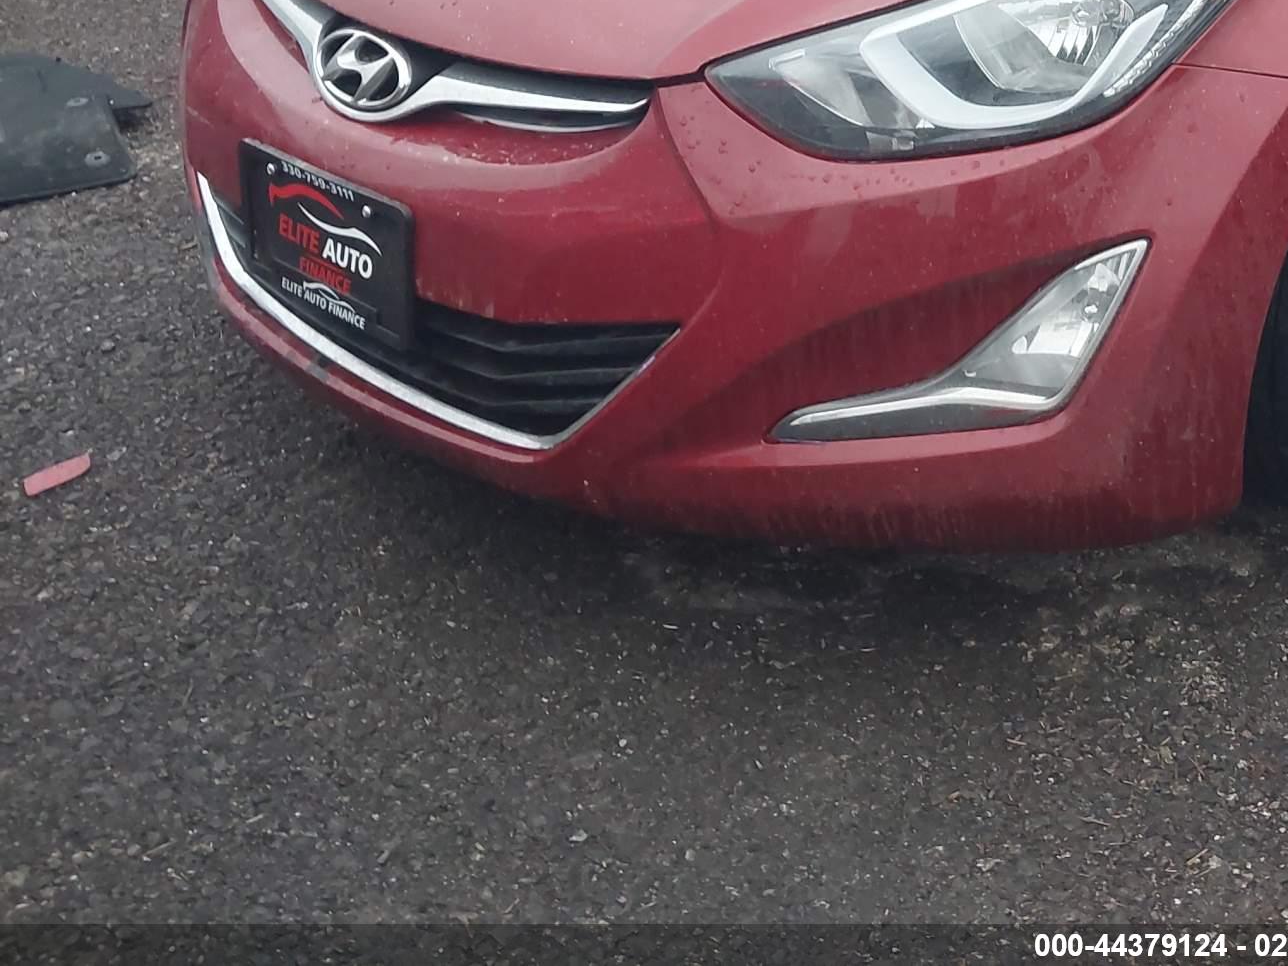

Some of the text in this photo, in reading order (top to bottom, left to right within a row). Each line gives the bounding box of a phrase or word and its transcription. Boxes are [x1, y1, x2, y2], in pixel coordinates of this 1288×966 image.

[282, 161, 355, 202] 330-759-3111
[278, 213, 373, 279] ELITE AUTO
[299, 257, 352, 294] FINANCE
[281, 277, 366, 331] ELITE AUTO FINANCE
